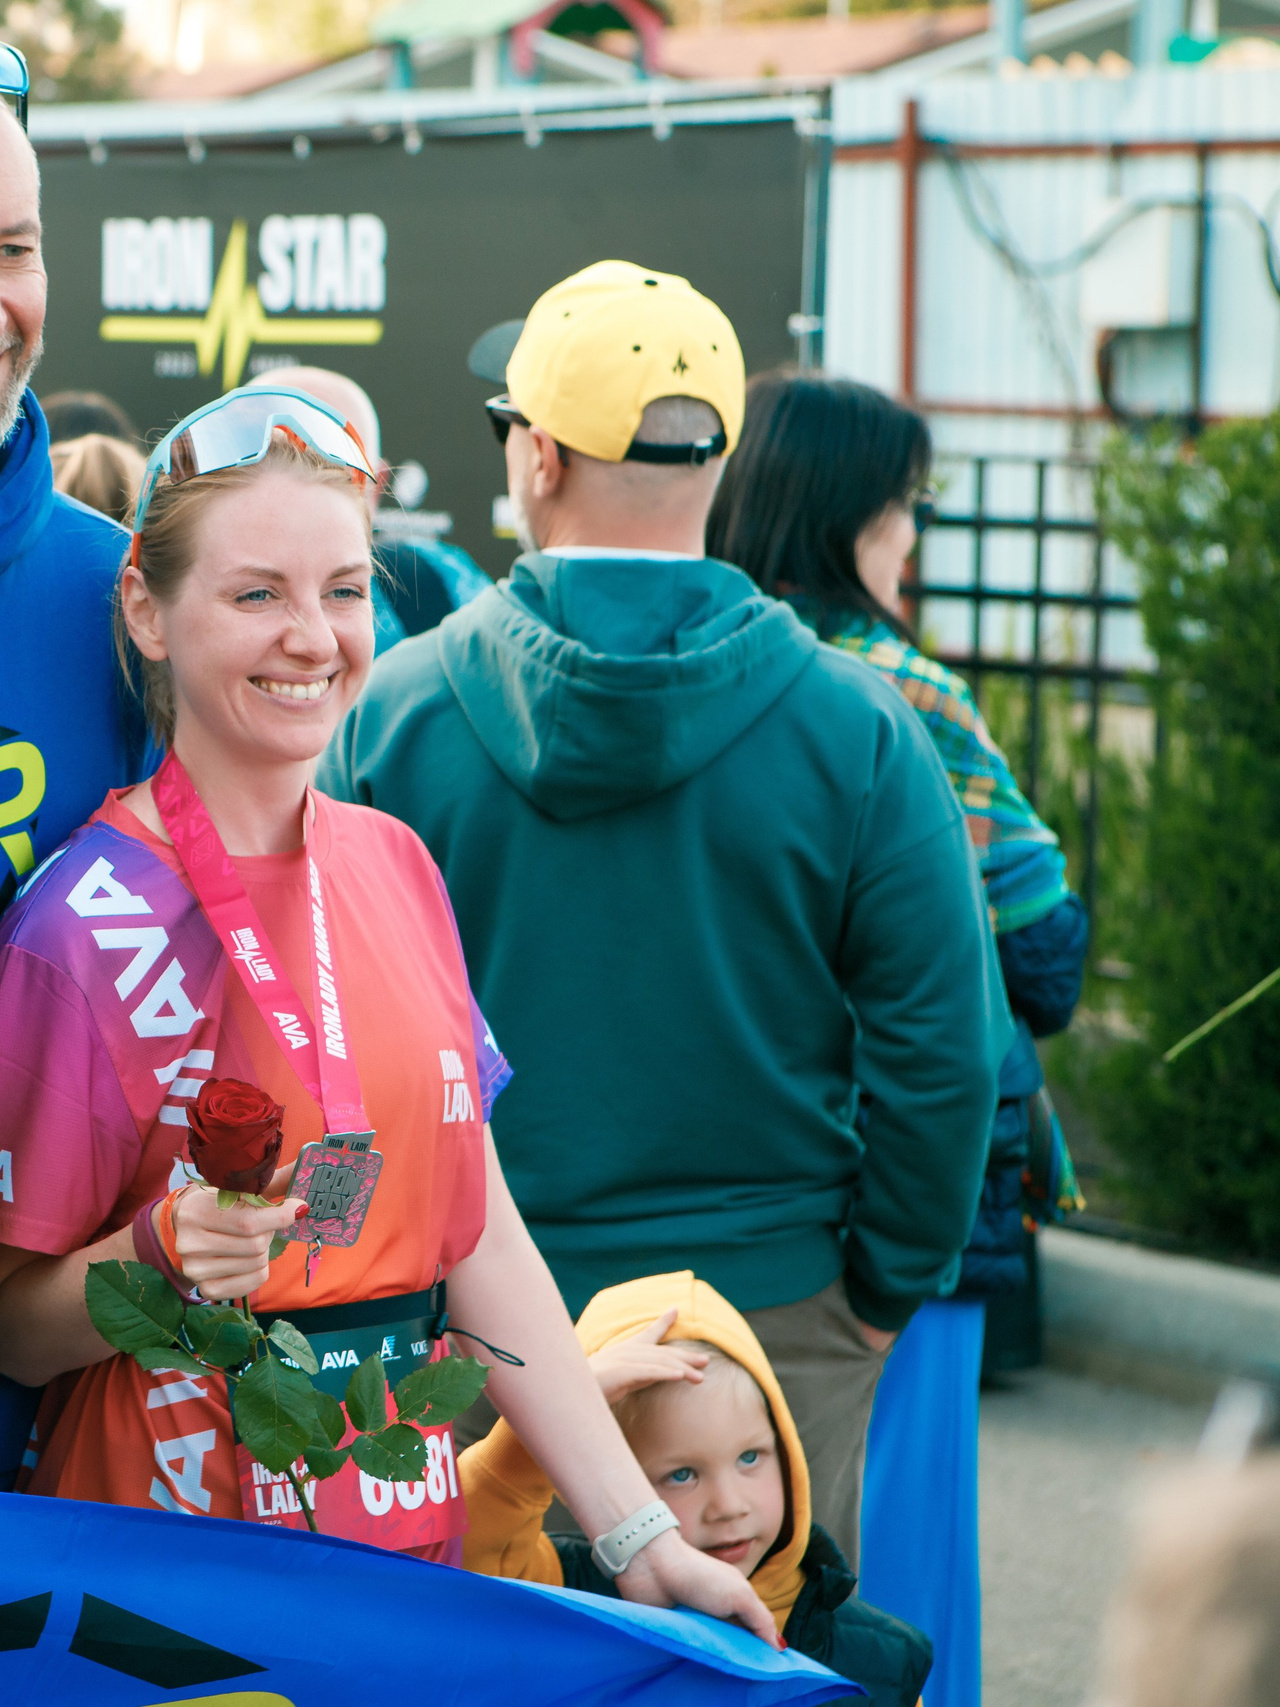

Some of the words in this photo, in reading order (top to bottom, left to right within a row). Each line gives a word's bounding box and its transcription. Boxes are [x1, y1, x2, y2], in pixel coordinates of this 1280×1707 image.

[101, 216, 214, 312] IRON
[257, 212, 387, 313] STAR
[236, 927, 260, 951] IRON
[251, 957, 277, 981] LADY
[272, 1011, 311, 1050] AVA
[317, 963, 347, 1060] IRONLADY
[327, 1138, 345, 1149] IRON
[350, 1141, 369, 1153] LADY
[320, 1349, 361, 1371] AVA
[254, 1479, 317, 1517] LADY
